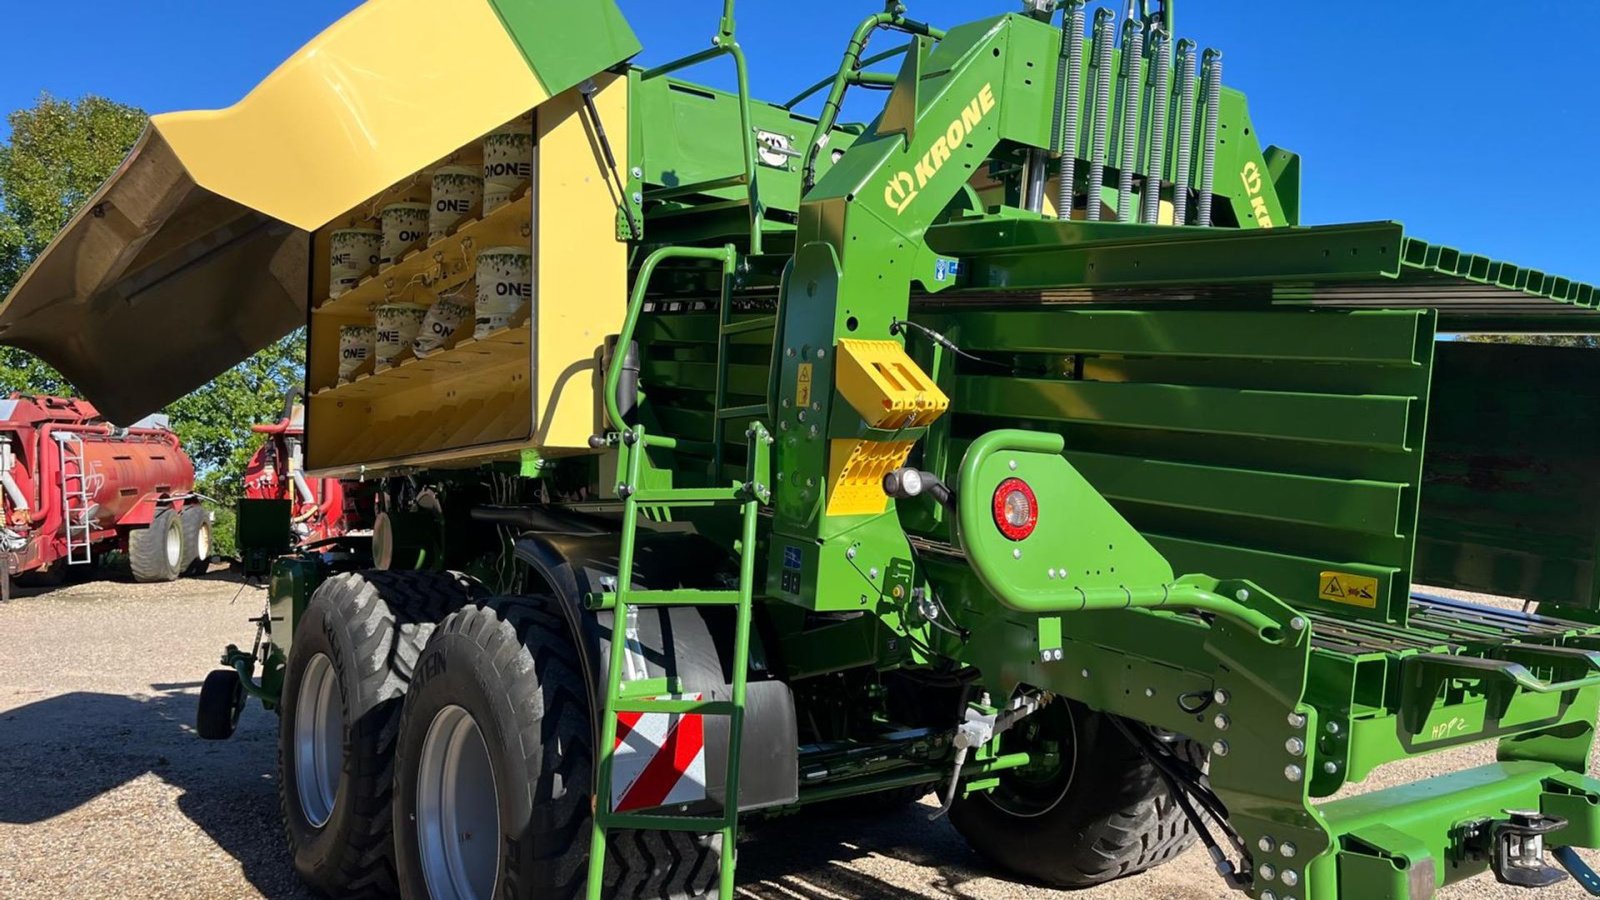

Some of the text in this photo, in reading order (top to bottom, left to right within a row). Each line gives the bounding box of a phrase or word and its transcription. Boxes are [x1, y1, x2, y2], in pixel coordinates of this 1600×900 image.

[913, 82, 996, 189] KRONE
[494, 163, 530, 176] ONE
[437, 200, 469, 212] ONE
[399, 231, 422, 241] ON
[332, 253, 350, 265] ONE
[496, 282, 531, 296] ONE
[433, 322, 454, 337] ON
[377, 331, 399, 342] ONE
[343, 348, 366, 359] ONE
